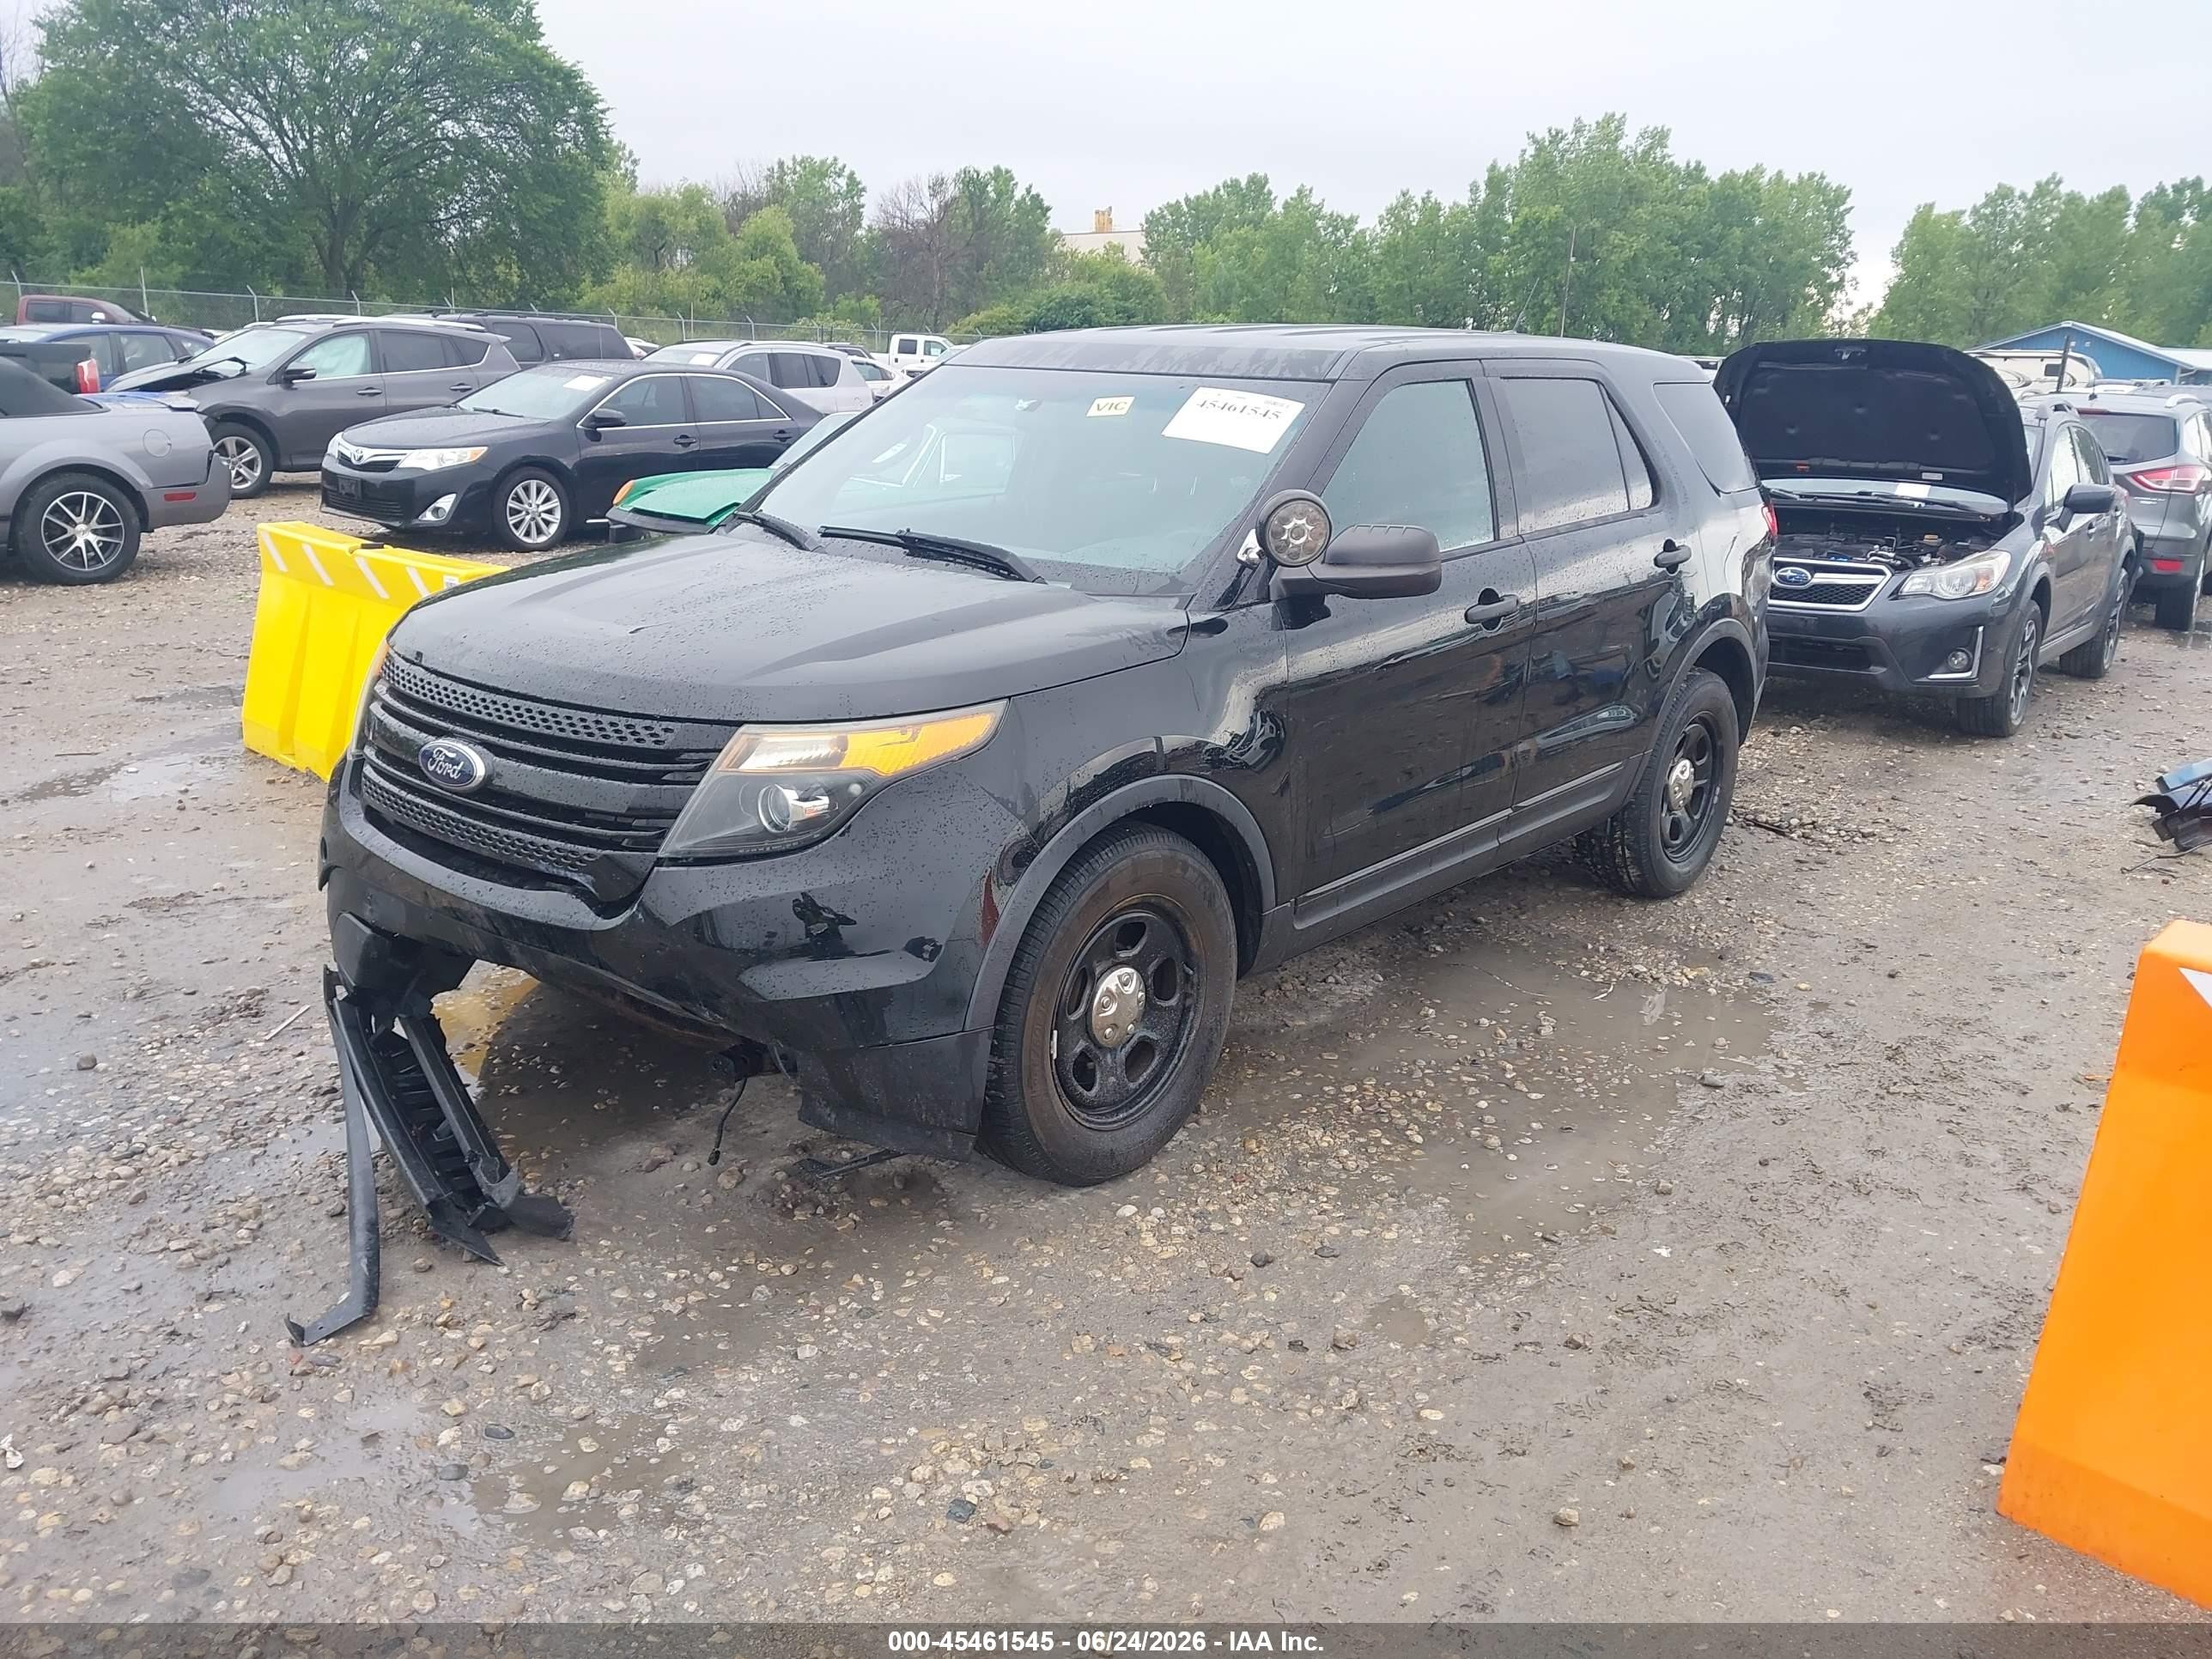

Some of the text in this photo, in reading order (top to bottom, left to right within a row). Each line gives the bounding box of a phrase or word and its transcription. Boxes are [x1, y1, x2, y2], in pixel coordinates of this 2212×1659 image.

[1097, 401, 1127, 412] VIC
[1196, 400, 1282, 419] 45461545
[428, 747, 465, 780] Ford
